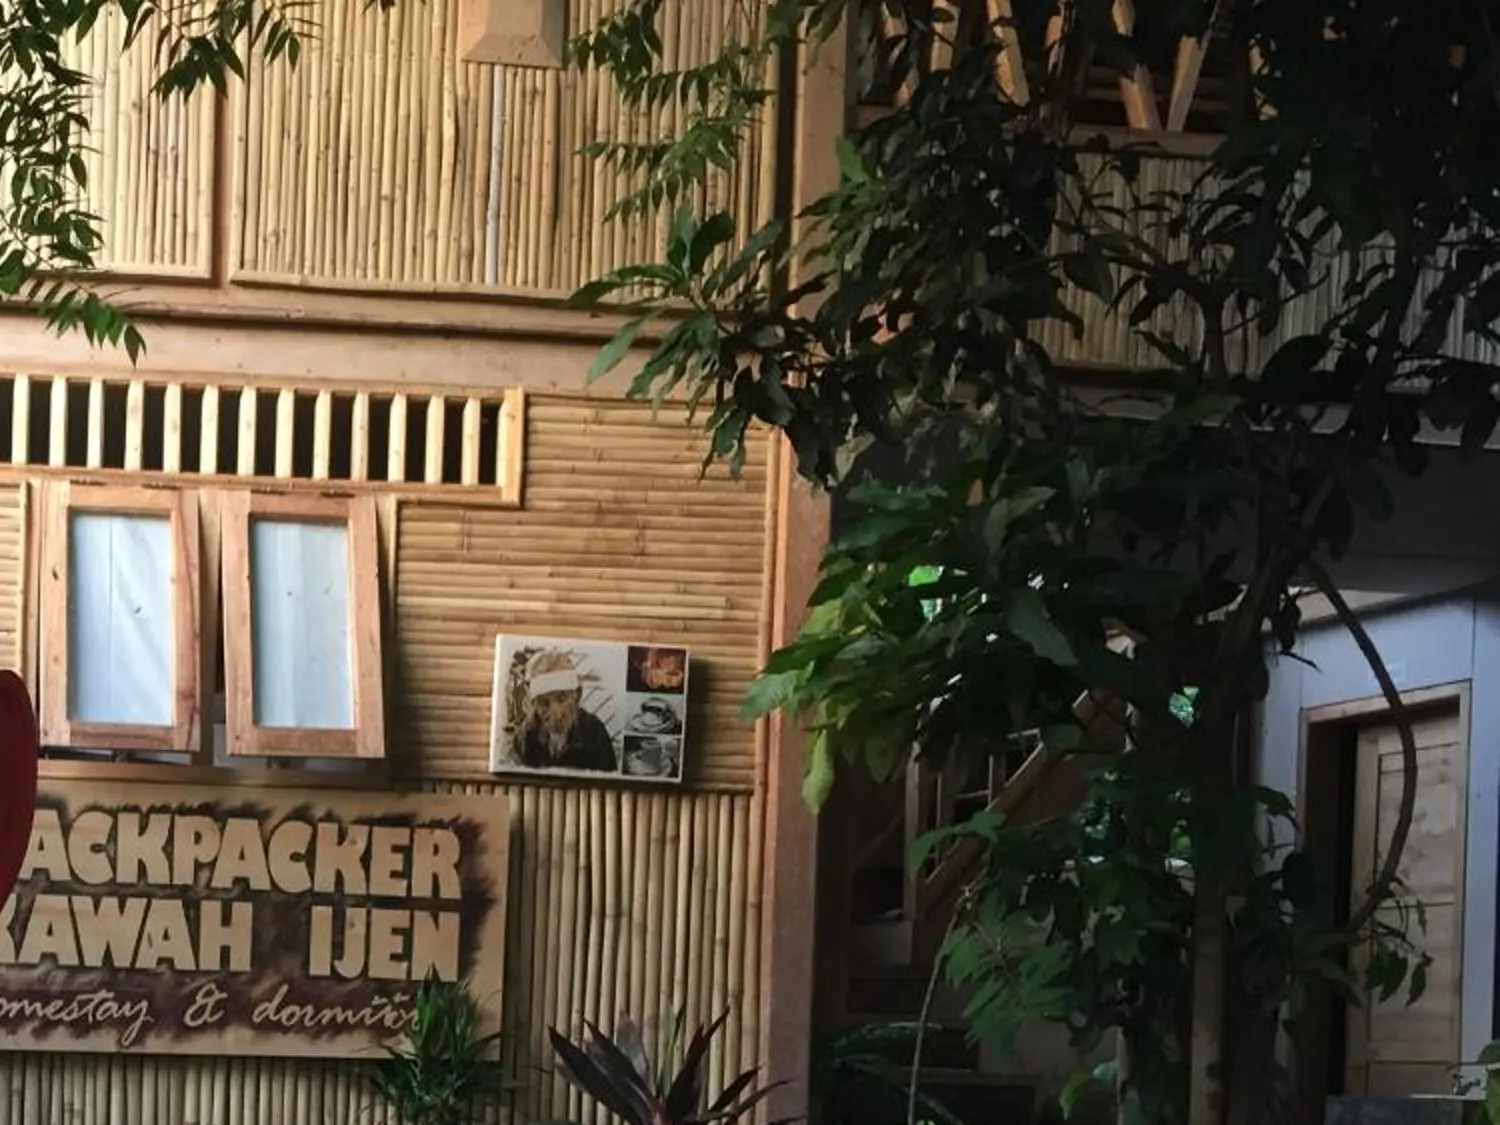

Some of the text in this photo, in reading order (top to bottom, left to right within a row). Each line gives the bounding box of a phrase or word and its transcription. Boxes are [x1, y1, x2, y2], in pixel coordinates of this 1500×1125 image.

[18, 809, 461, 899] ACKPACKER
[309, 905, 459, 983] IJEN
[183, 982, 228, 1027] &
